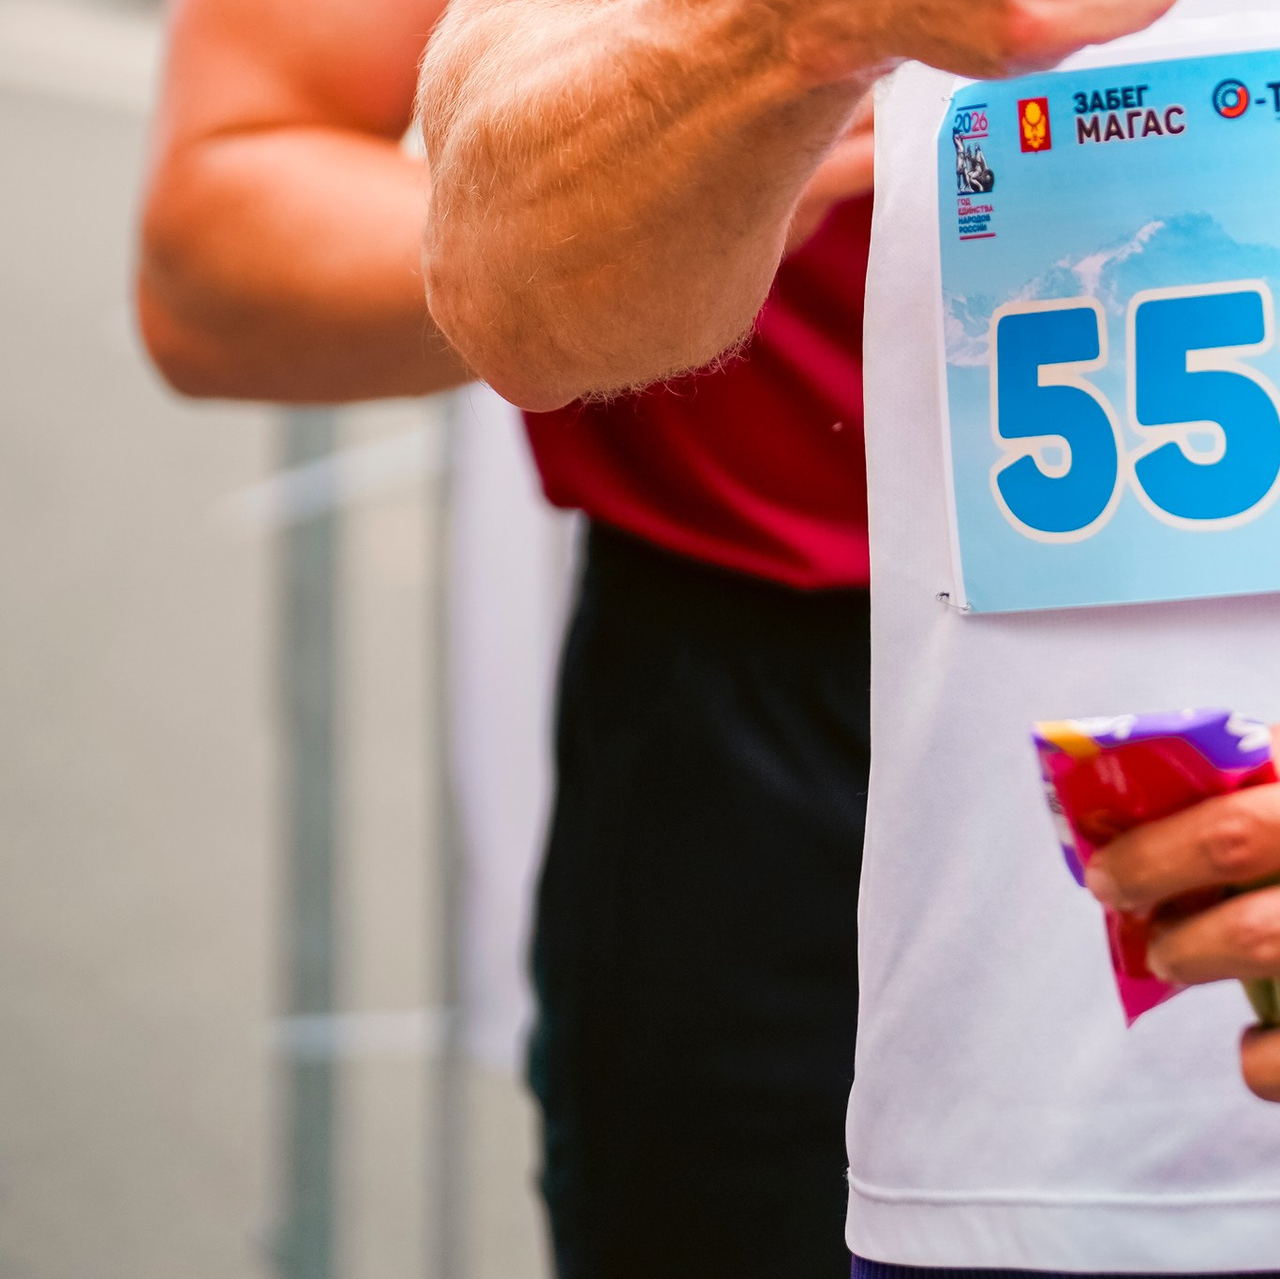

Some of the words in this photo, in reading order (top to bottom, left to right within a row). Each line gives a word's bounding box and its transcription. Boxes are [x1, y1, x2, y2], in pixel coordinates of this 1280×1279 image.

[1072, 84, 1149, 115] ЗАБЕГ
[955, 111, 988, 133] 2026
[1075, 106, 1186, 145] МАГАС
